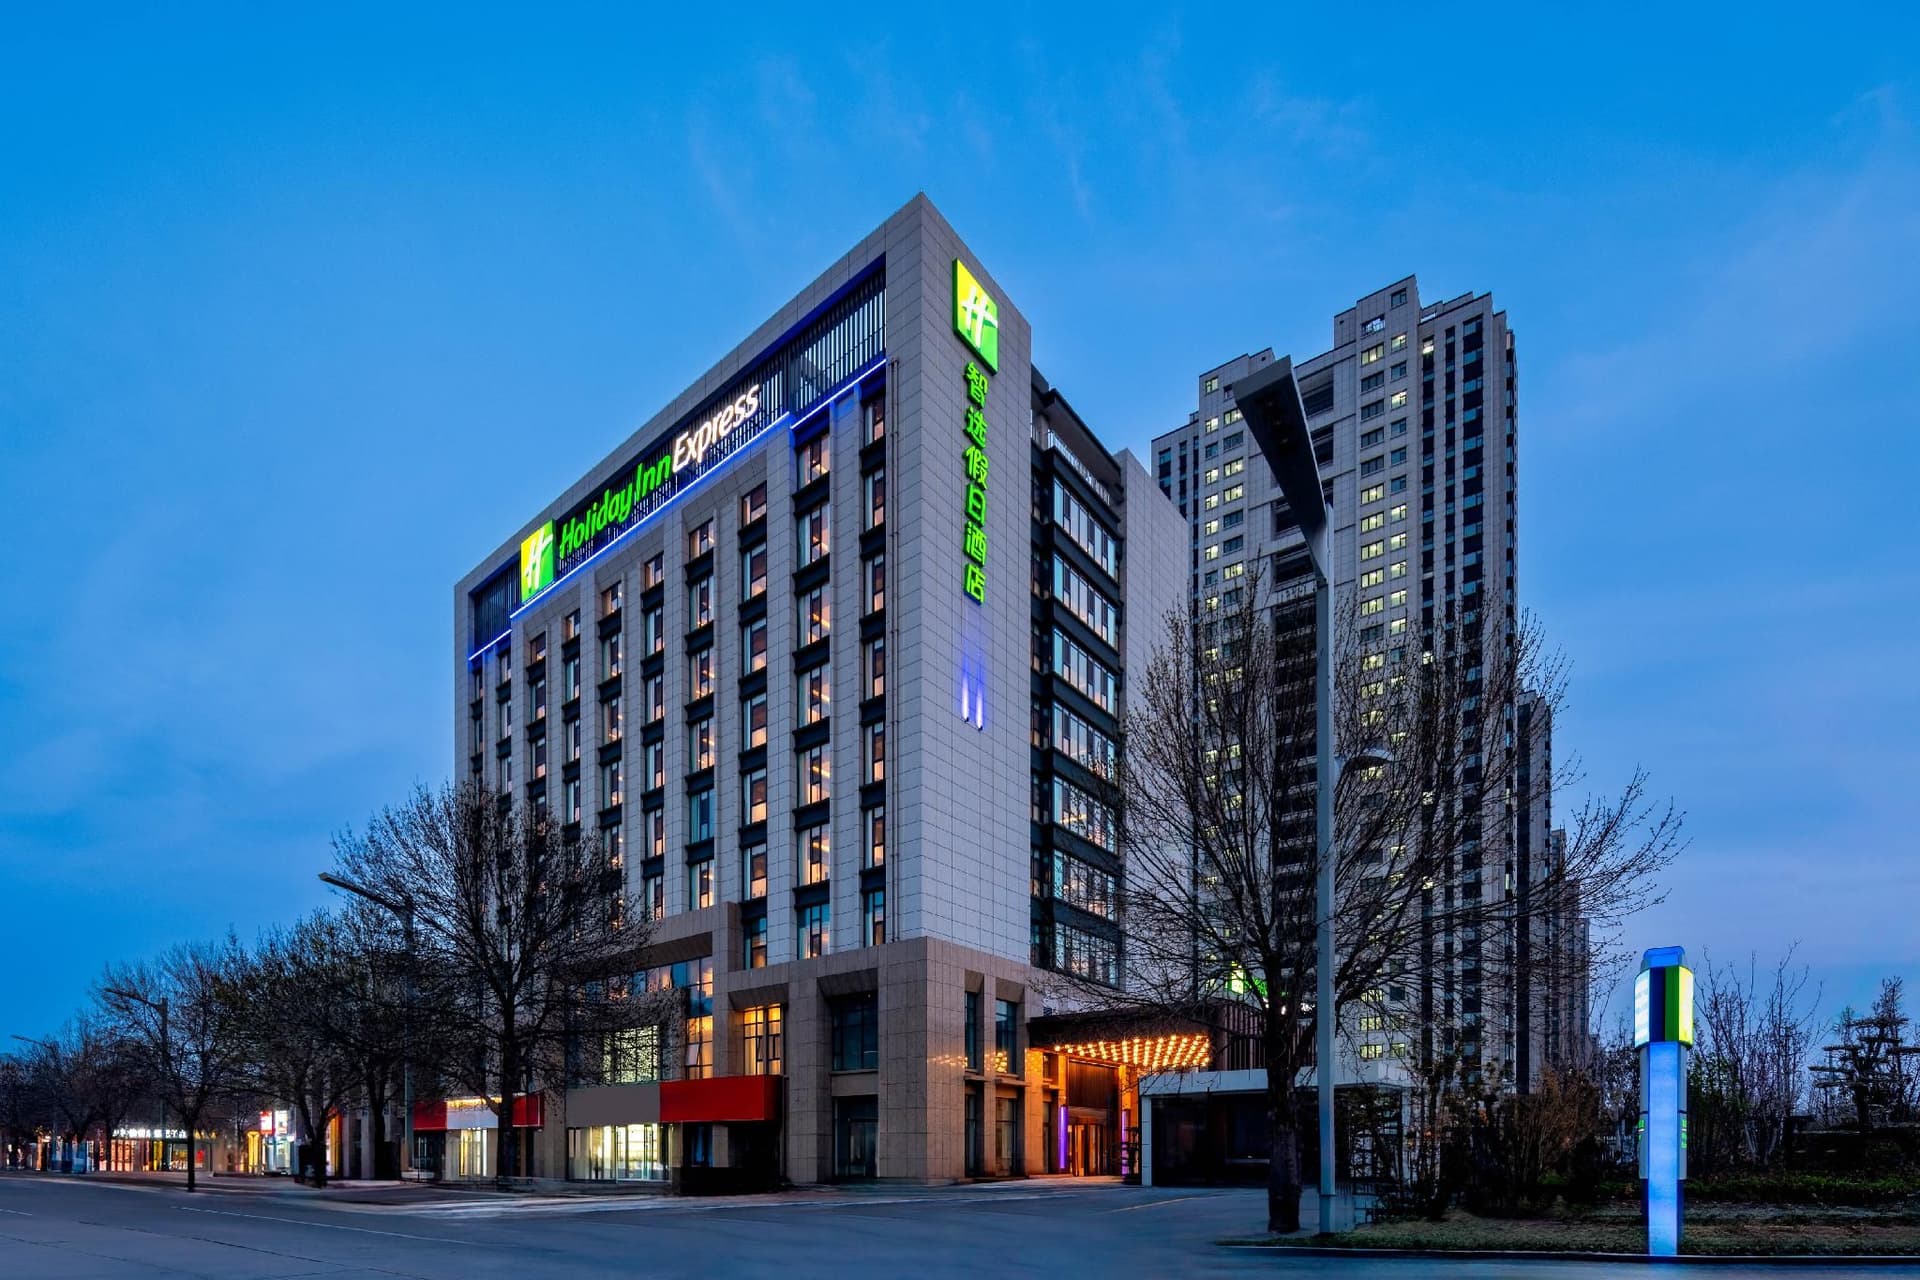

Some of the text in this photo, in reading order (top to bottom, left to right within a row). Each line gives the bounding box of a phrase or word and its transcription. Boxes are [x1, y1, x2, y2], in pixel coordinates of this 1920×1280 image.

[672, 384, 760, 473] Express
[964, 361, 989, 604] 智选假日酒店
